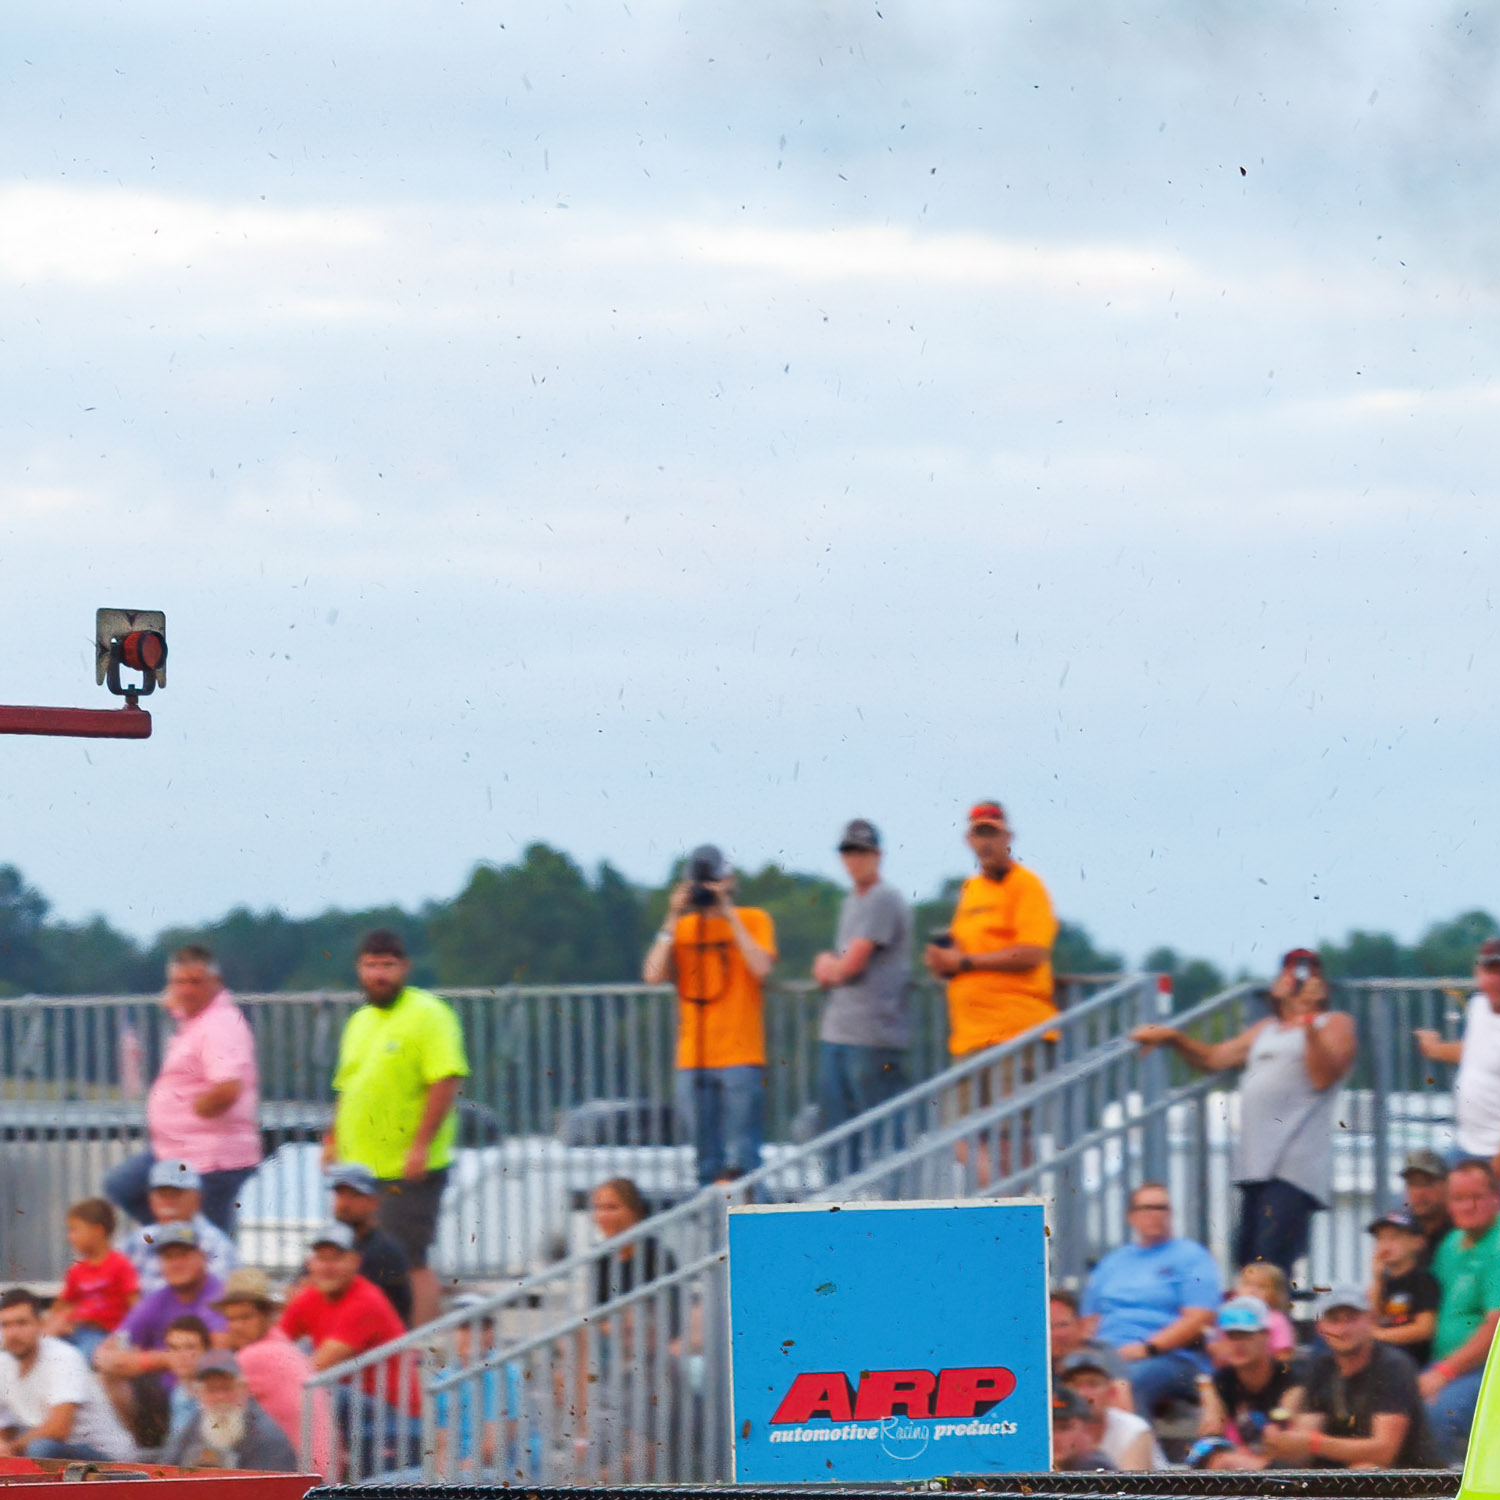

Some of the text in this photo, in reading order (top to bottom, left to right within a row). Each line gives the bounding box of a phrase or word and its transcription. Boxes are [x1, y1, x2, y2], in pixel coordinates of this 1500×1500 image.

[769, 1367, 1017, 1425] ARP
[769, 1423, 878, 1443] automotive
[933, 1420, 1018, 1441] products
